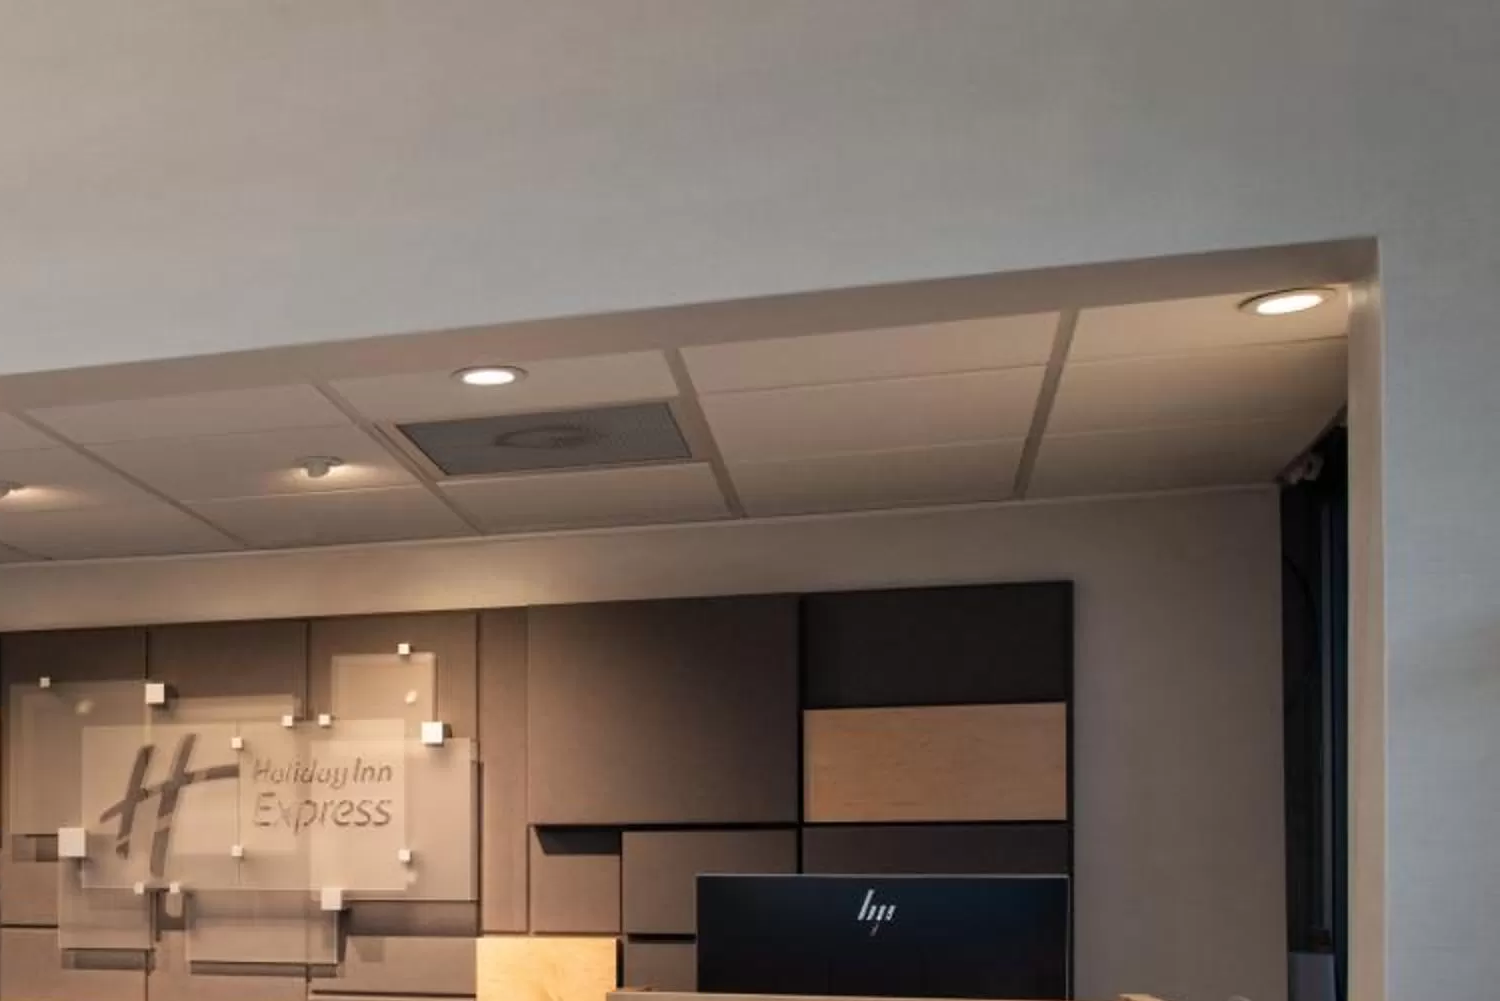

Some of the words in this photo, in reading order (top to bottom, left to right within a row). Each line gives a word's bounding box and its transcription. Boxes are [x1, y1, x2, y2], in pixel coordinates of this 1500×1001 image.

[253, 759, 348, 789] Holiday
[353, 757, 393, 784] Inn
[254, 792, 392, 835] Express
